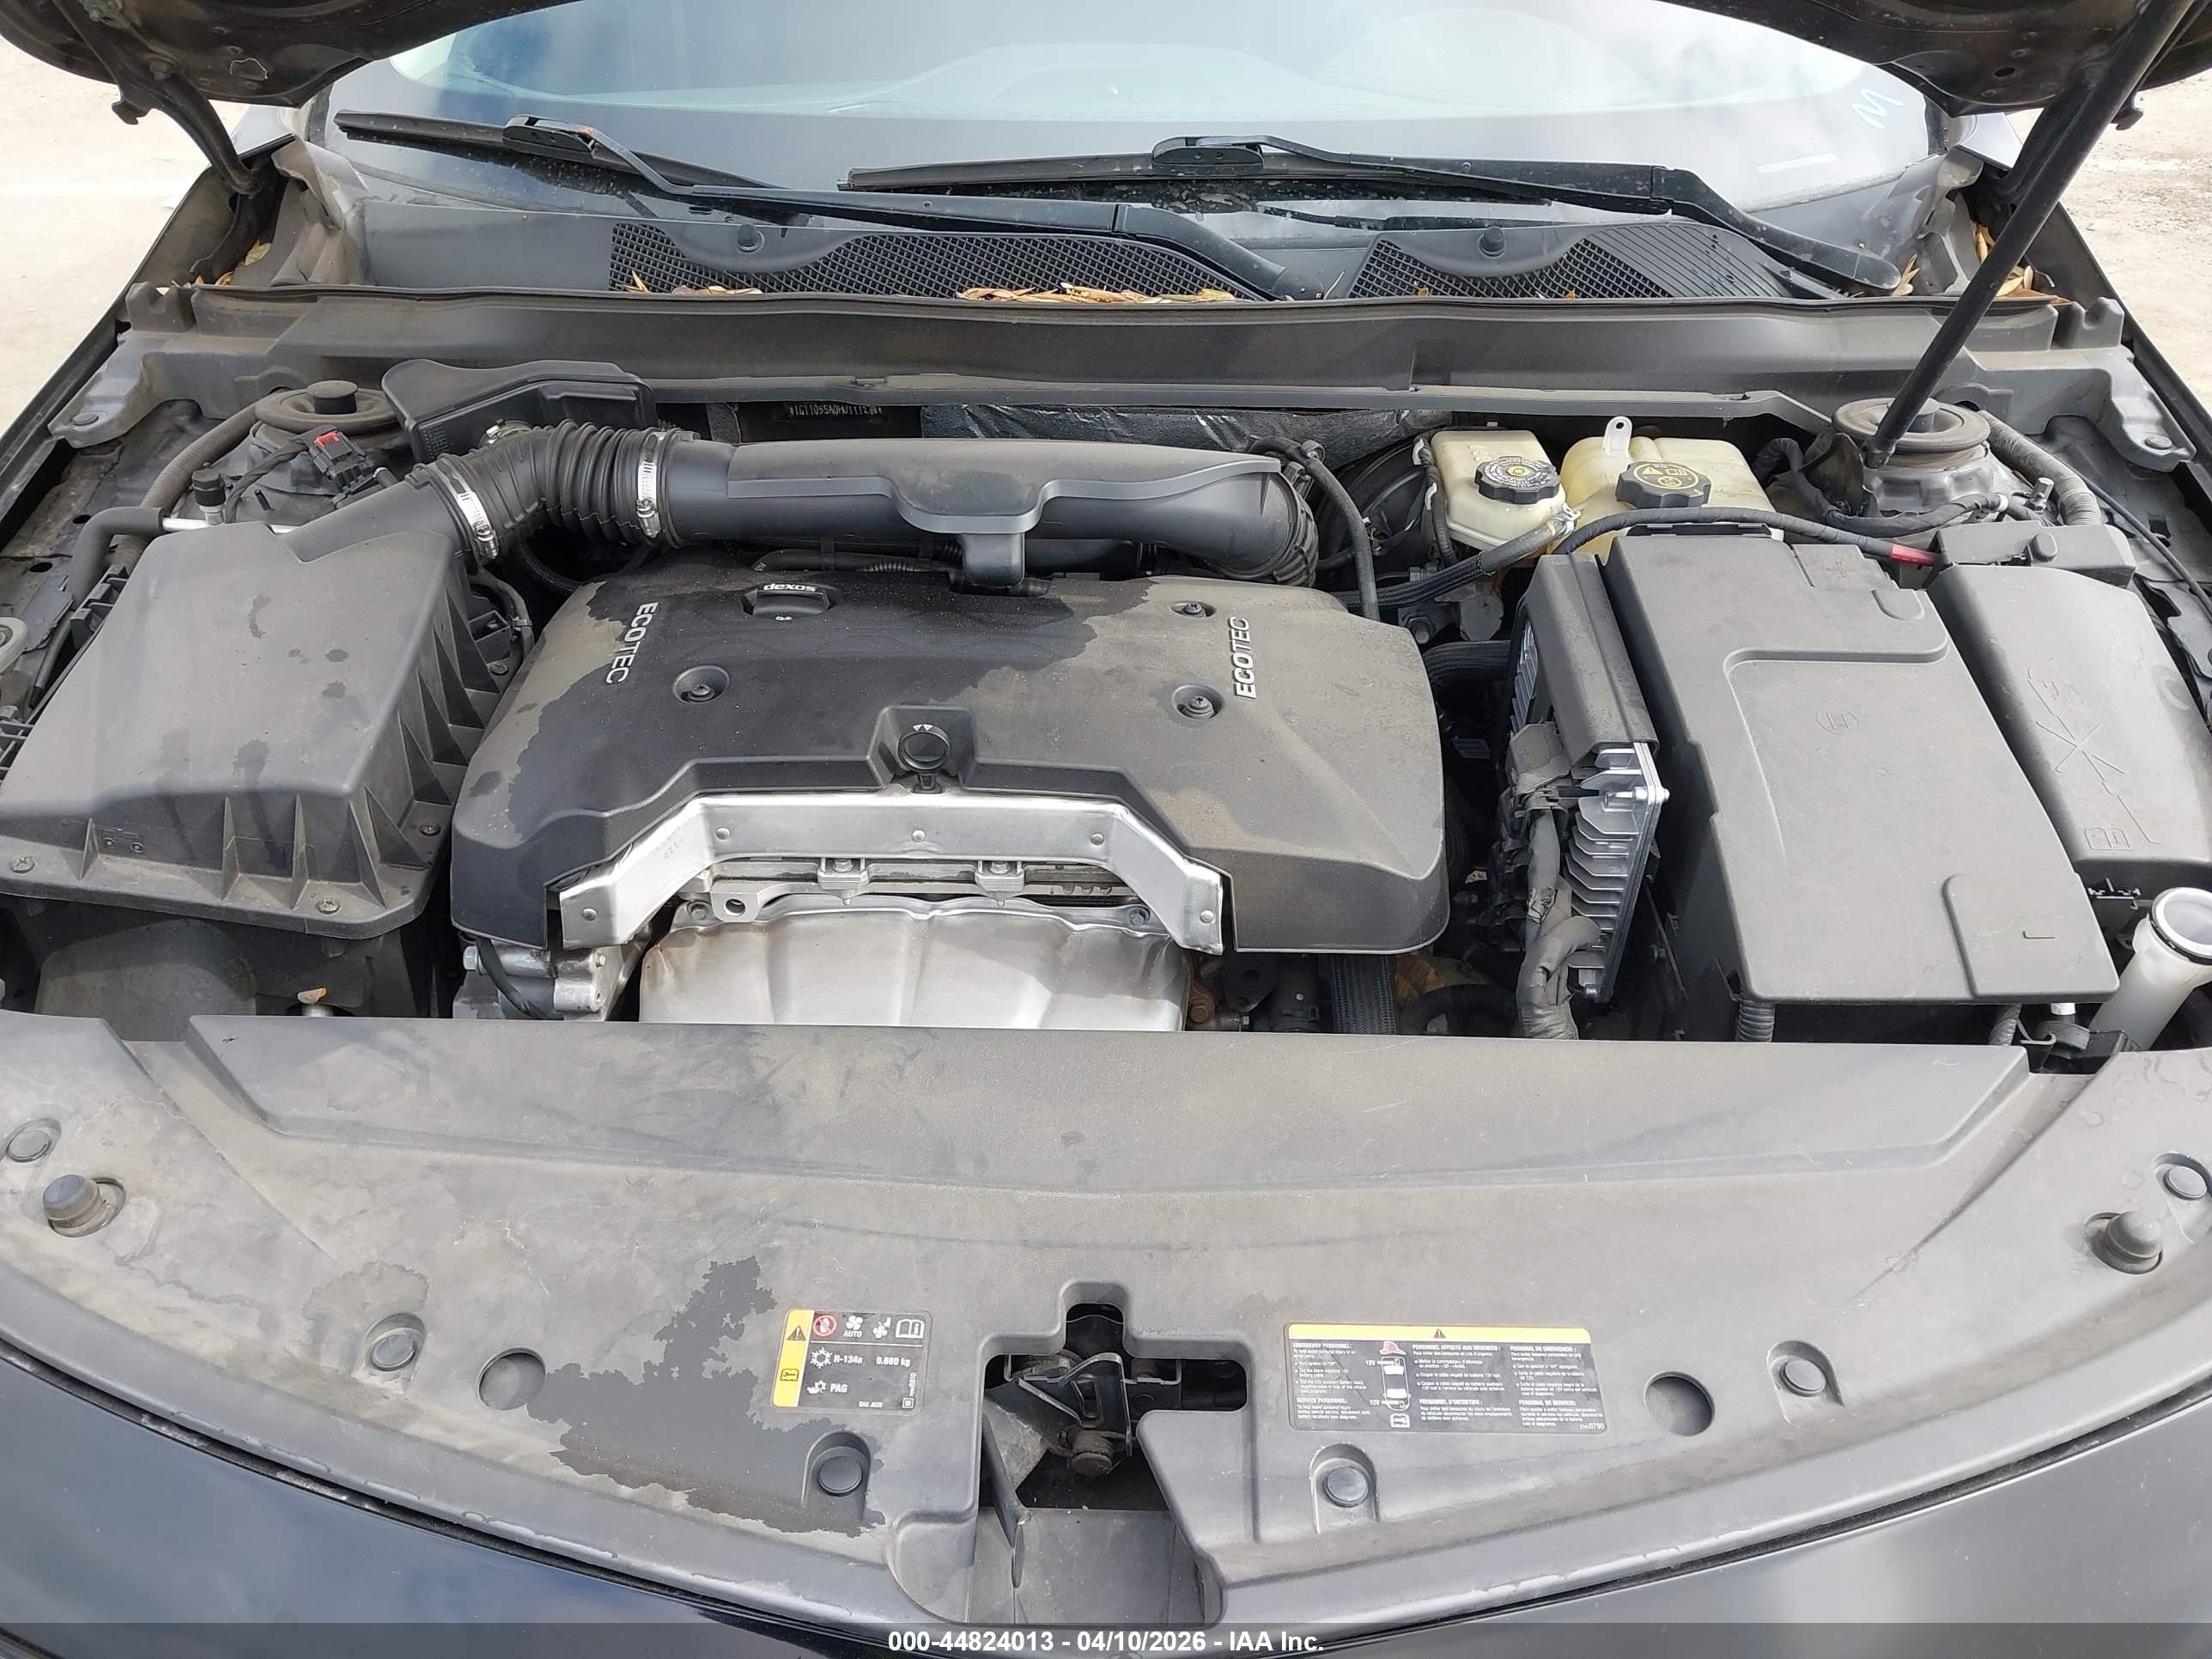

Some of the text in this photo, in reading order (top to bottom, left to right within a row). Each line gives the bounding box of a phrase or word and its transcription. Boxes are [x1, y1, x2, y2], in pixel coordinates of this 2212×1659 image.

[763, 583, 818, 592] dexos
[606, 602, 659, 684] ECOTEC
[1230, 617, 1256, 699] ECOTEC
[833, 1354, 863, 1364] R-134a
[901, 1358, 911, 1368] kg
[830, 1382, 848, 1393] PAG
